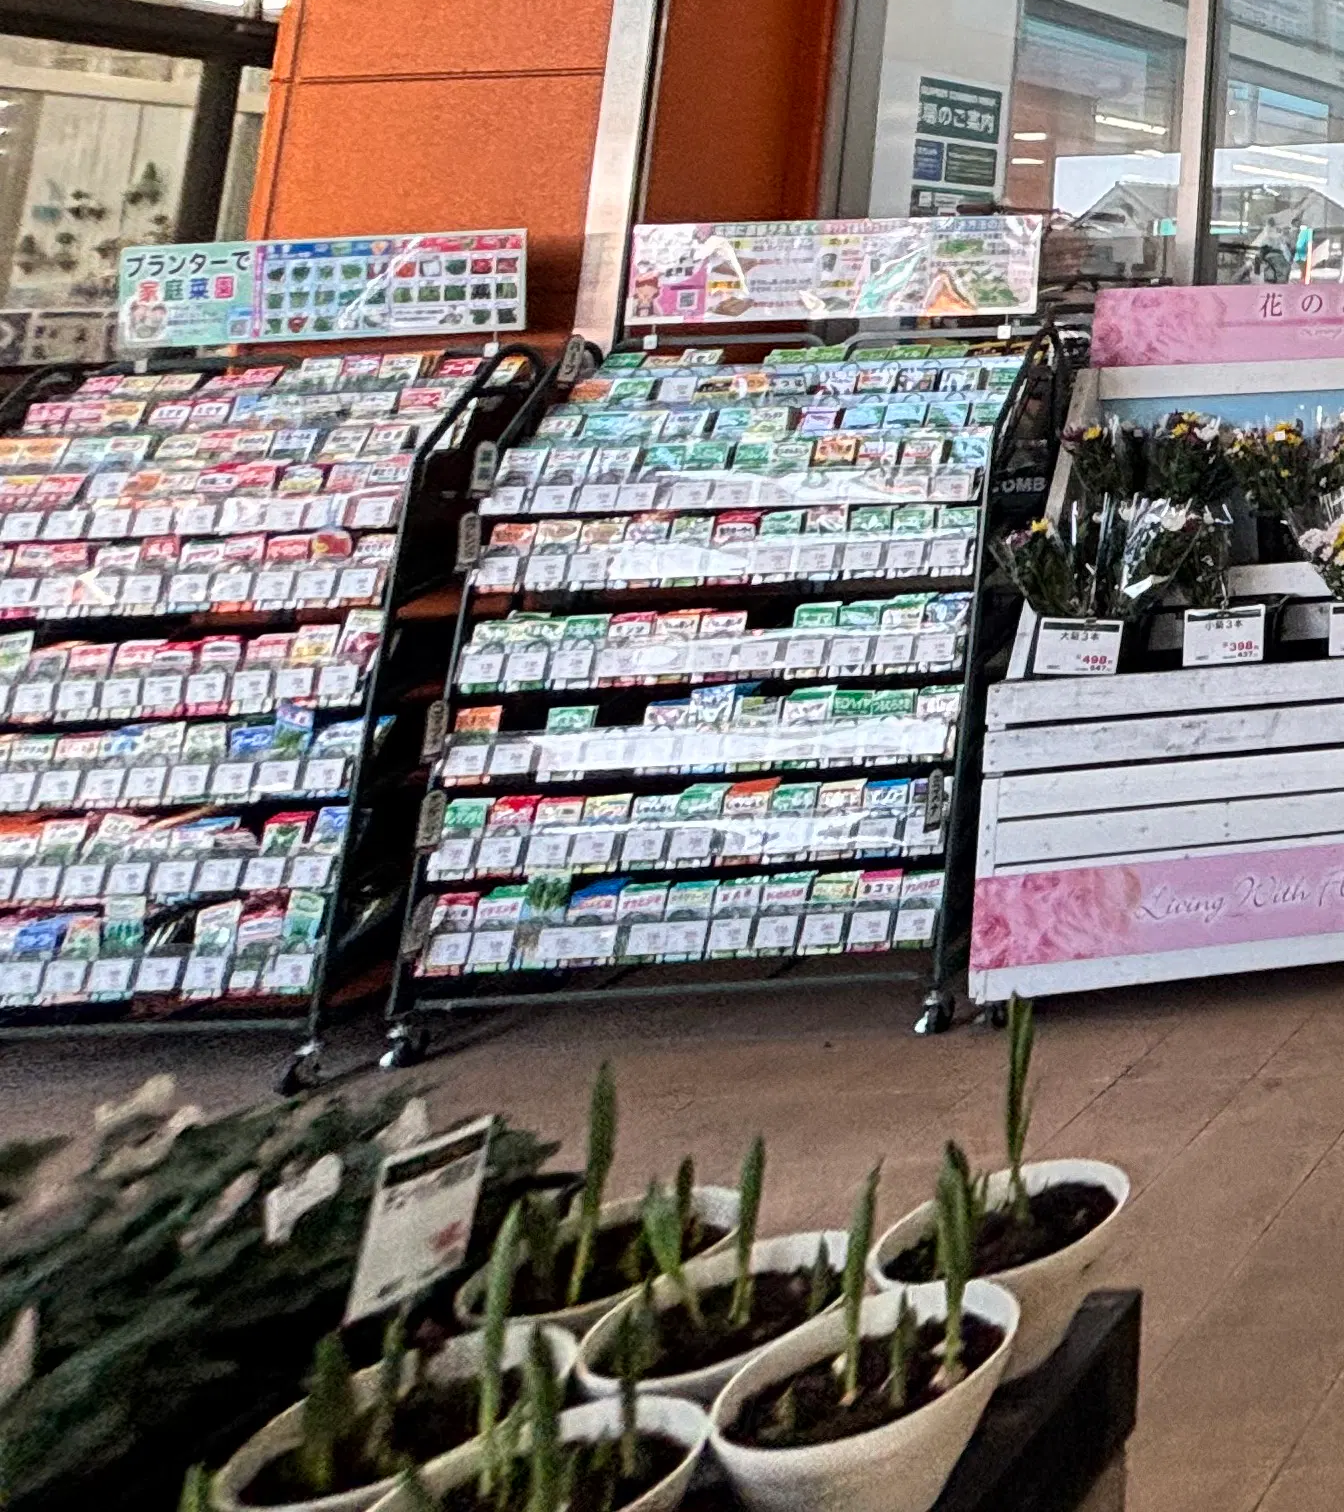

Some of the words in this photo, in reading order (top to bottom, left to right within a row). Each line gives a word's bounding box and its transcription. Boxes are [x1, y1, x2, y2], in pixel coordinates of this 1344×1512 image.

[126, 250, 250, 278] プランターで
[137, 276, 235, 301] 家庭菜園
[1135, 886, 1226, 923] Living
[1234, 876, 1312, 909] With
